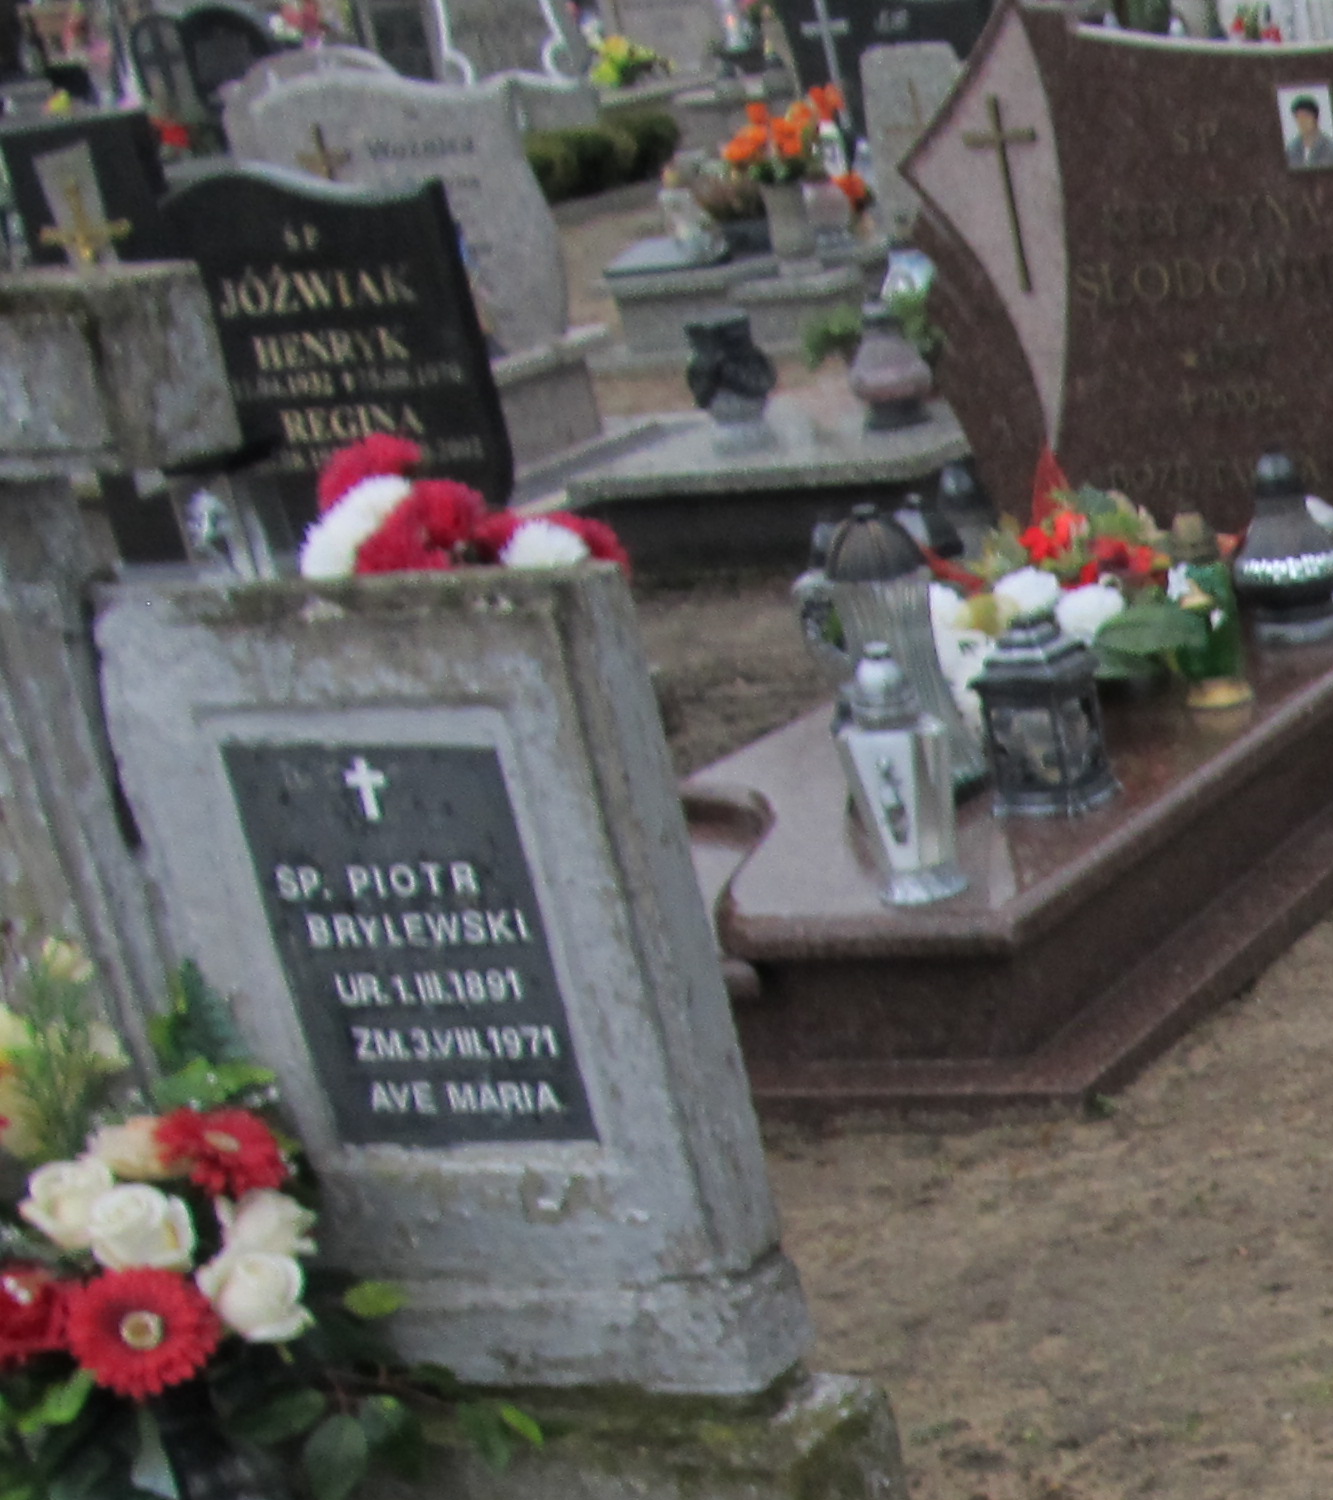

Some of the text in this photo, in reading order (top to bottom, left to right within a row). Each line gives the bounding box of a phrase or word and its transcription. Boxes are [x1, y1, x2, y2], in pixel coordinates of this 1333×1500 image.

[252, 325, 410, 371] HENRYK
[279, 403, 426, 444] REGINA
[346, 861, 481, 899] PIOTR
[304, 908, 532, 949] BRYLEWSKI
[370, 1080, 439, 1115] AVE
